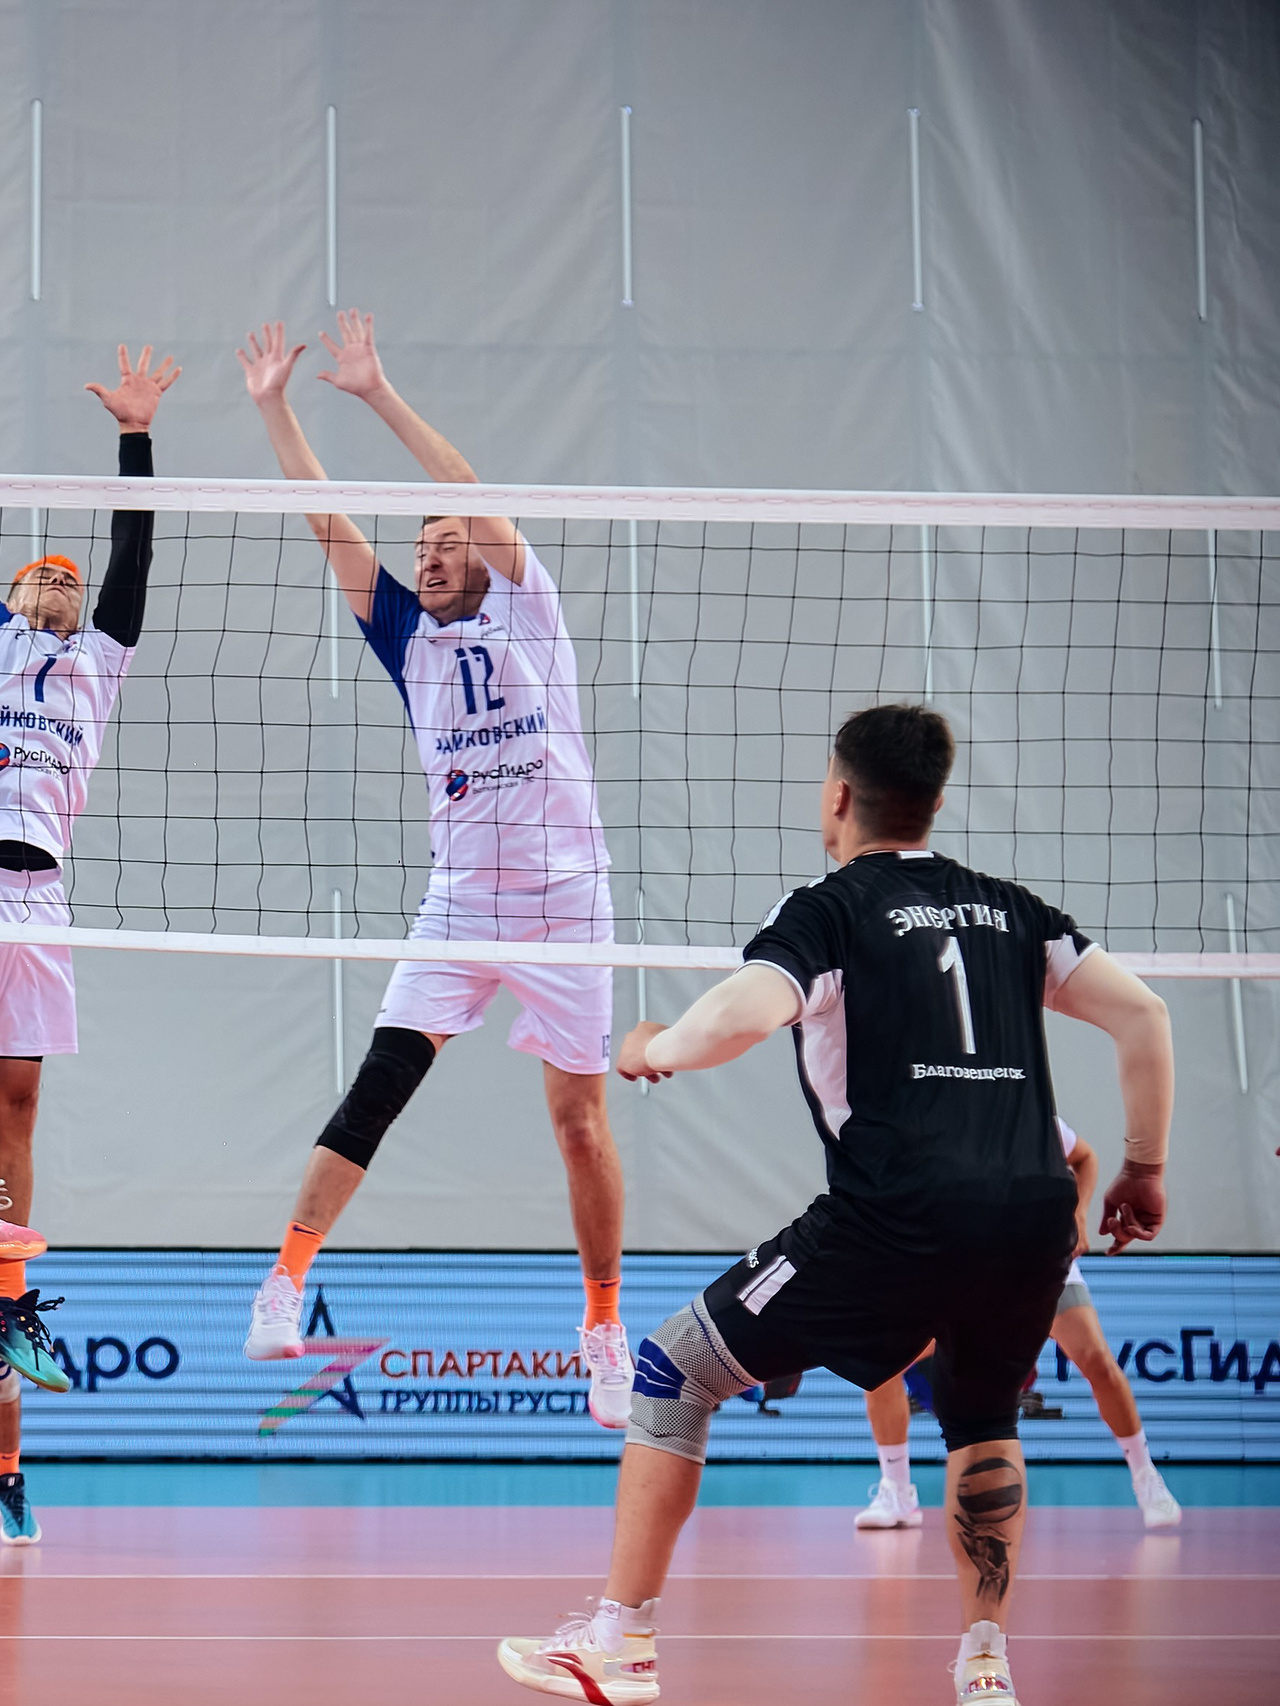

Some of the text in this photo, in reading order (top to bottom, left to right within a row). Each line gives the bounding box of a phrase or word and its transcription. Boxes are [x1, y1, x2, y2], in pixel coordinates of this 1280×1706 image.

[454, 645, 506, 715] 12
[938, 936, 976, 1054] 1
[380, 1350, 591, 1378] СПАРТАКИ
[379, 1390, 499, 1414] ГРУППЫ
